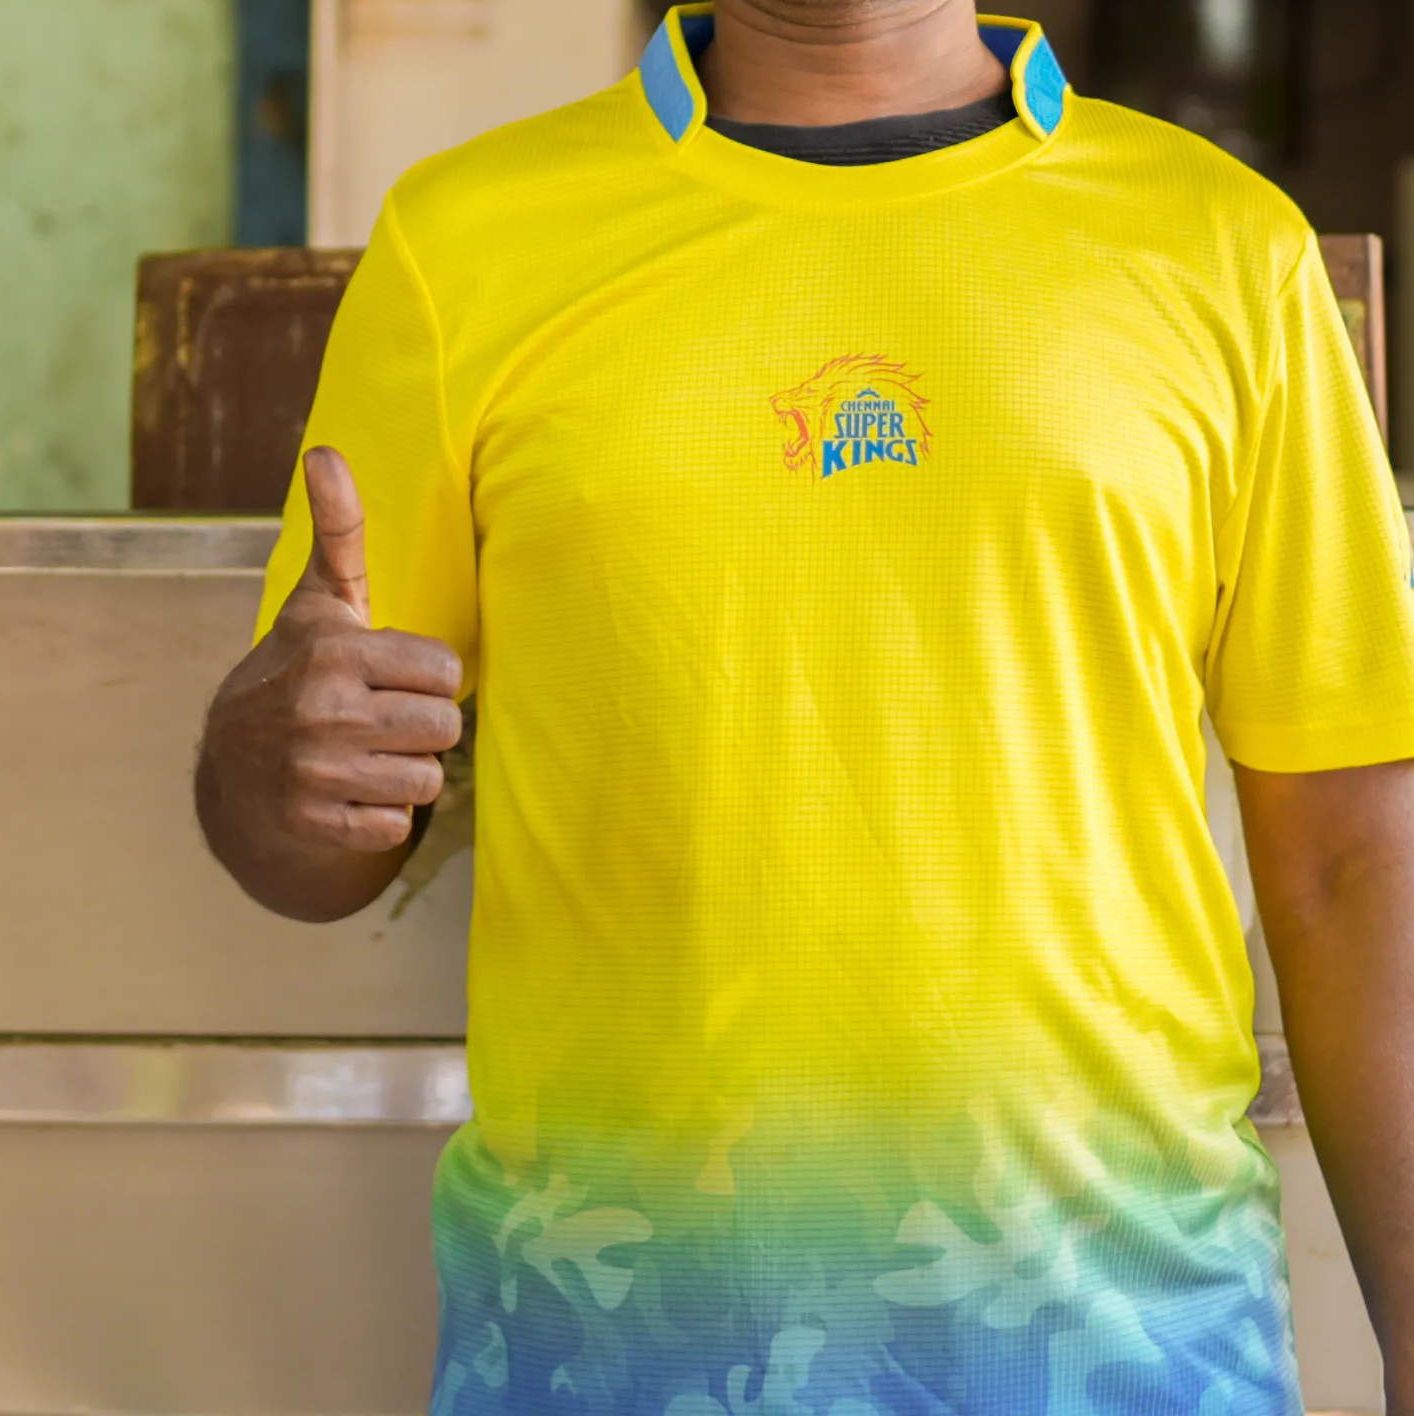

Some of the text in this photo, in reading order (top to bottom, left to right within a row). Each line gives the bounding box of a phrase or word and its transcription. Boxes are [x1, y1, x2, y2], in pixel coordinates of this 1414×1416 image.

[840, 400, 895, 412] CHENNAI
[834, 413, 905, 438] SUPER
[822, 439, 918, 478] KINGS
